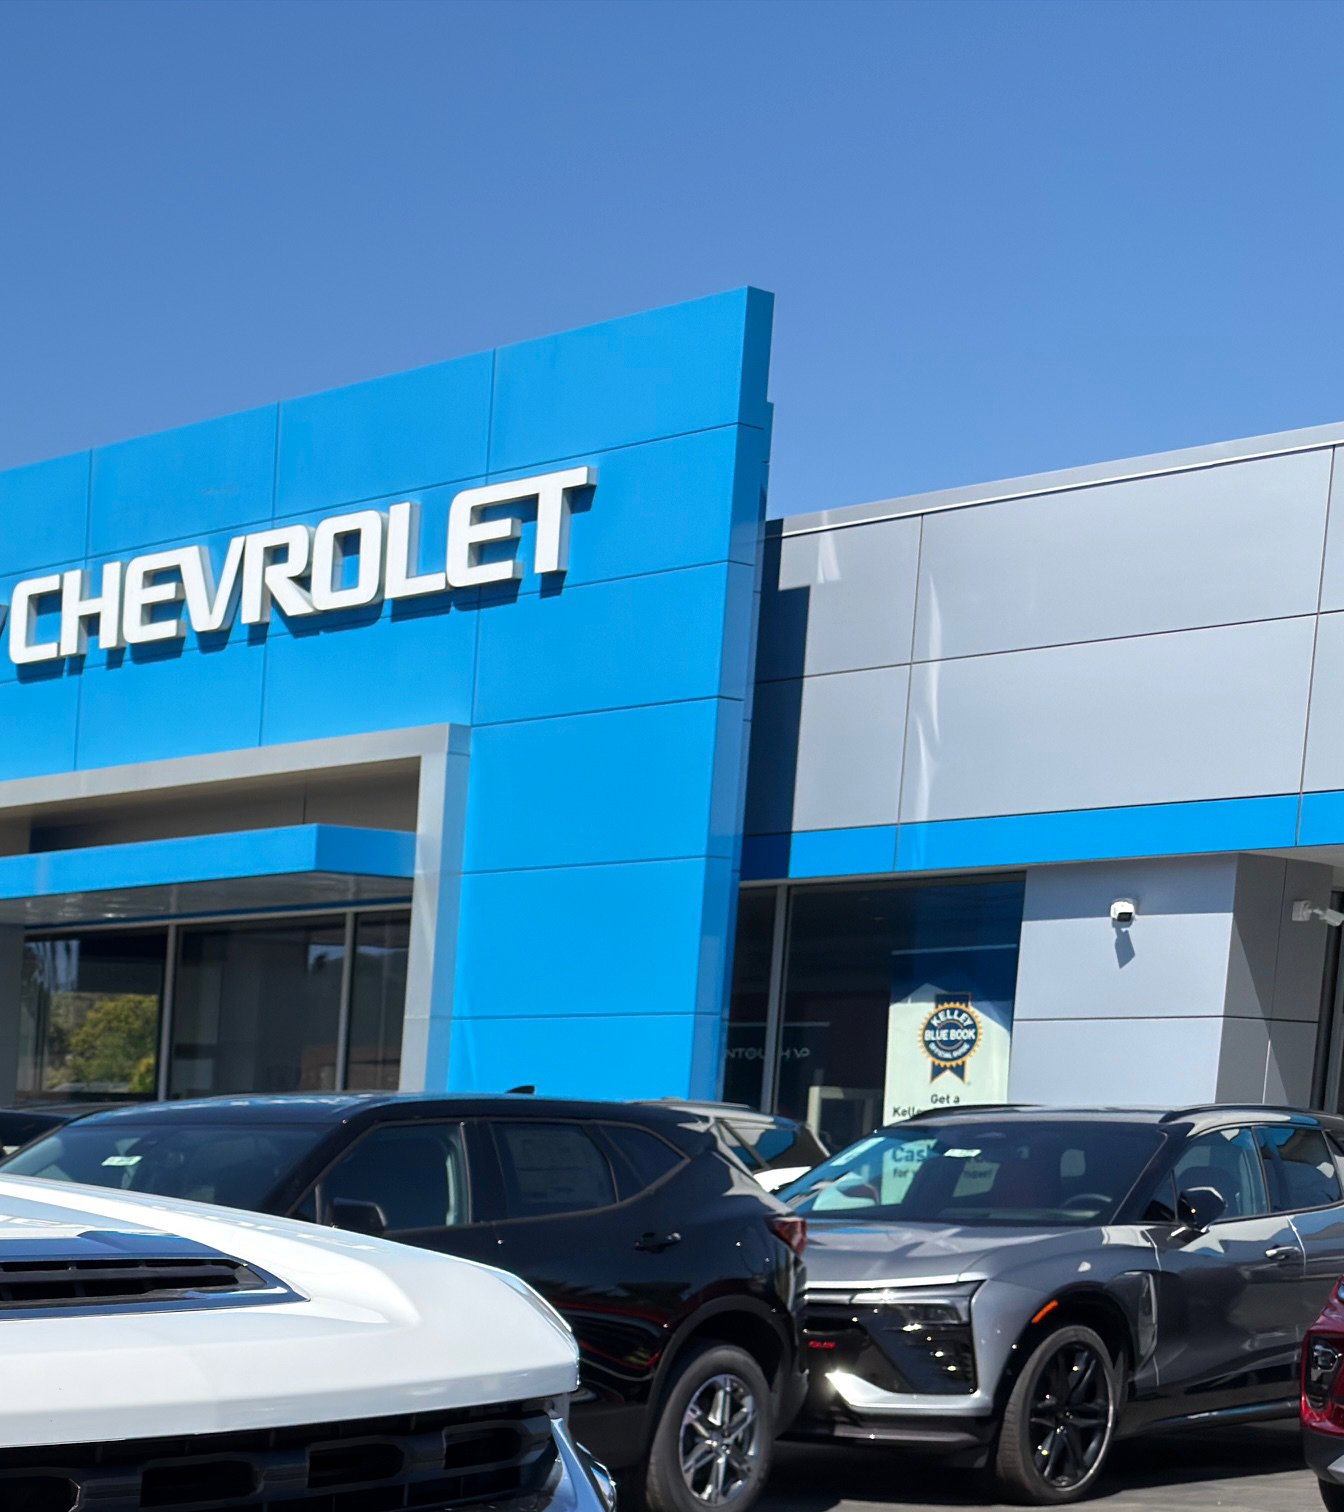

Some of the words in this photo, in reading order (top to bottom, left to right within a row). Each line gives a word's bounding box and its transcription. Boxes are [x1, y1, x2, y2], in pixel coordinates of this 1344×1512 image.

[9, 465, 598, 664] CHEVROLET
[930, 1009, 974, 1027] KELLEY
[924, 1029, 949, 1042] BLUE
[949, 1028, 976, 1041] BOOK
[930, 1093, 950, 1105] Get
[952, 1095, 961, 1104] a
[892, 1106, 923, 1118] Kelle
[892, 1144, 933, 1163] Cas
